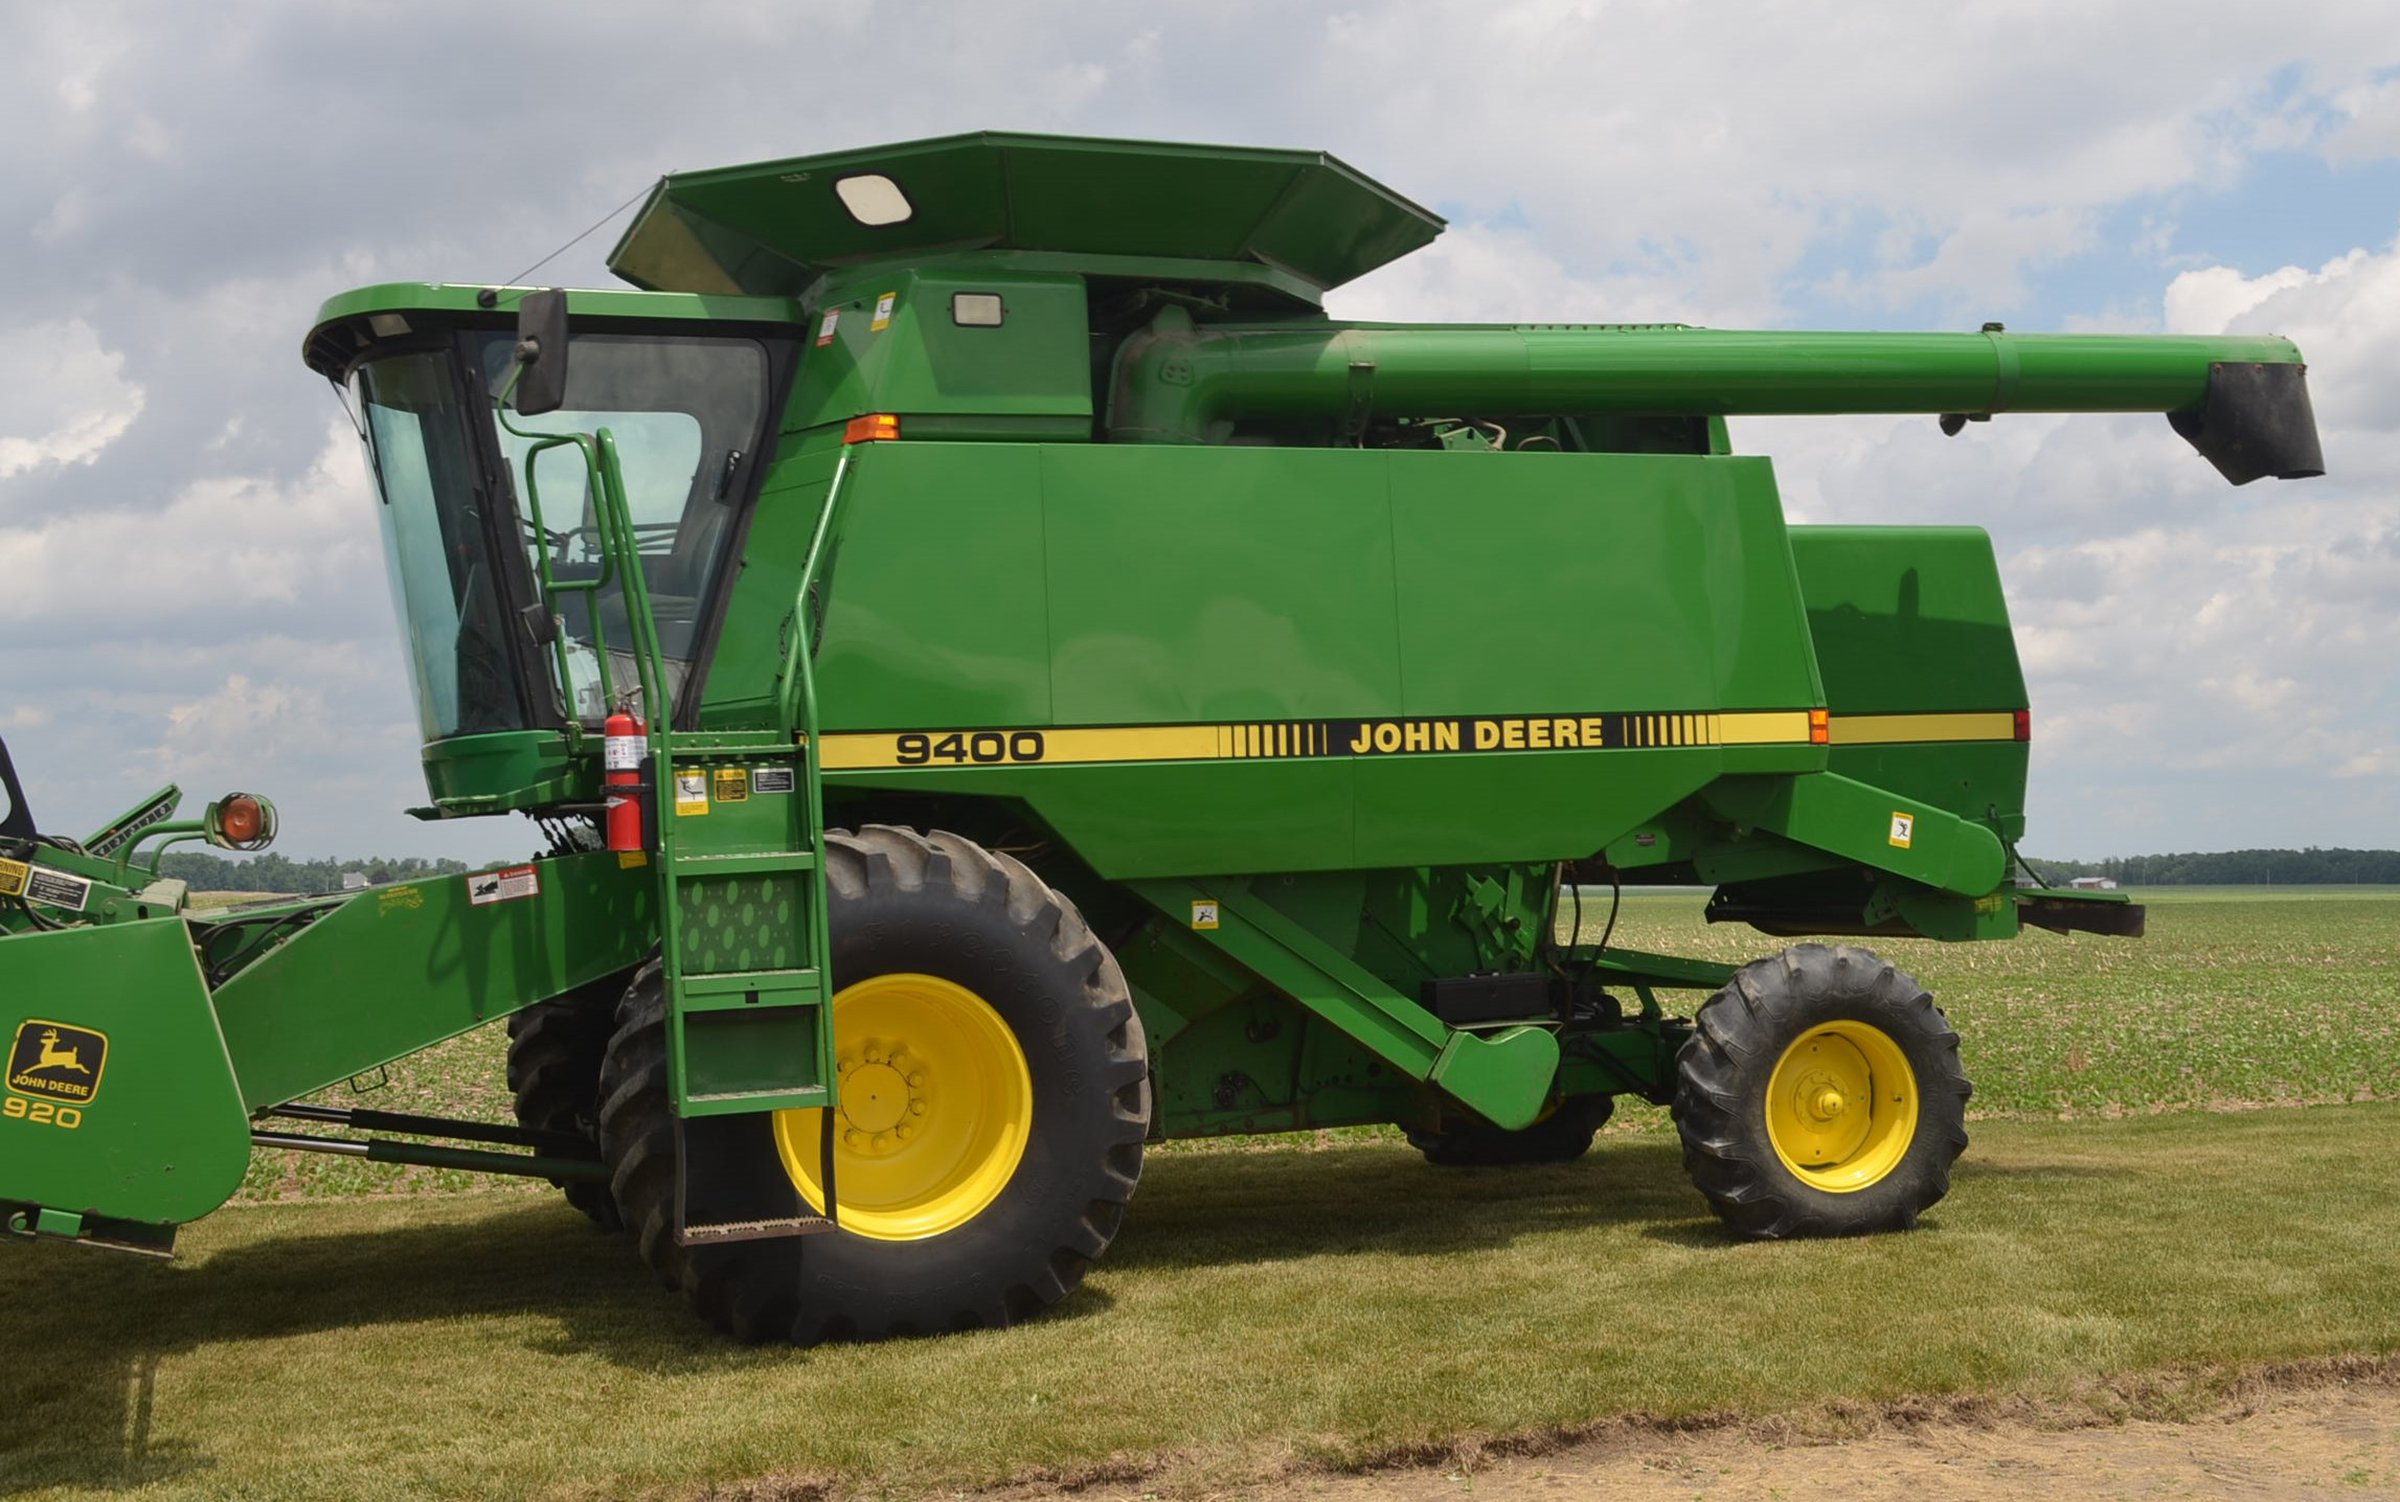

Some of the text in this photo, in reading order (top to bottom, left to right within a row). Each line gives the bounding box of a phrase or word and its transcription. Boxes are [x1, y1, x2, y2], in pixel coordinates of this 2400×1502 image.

[896, 731, 1045, 765] 9400
[1350, 717, 1603, 754] JOHN DEERE
[12, 1075, 89, 1096] JOHN DEERE
[3, 1096, 82, 1128] 920
